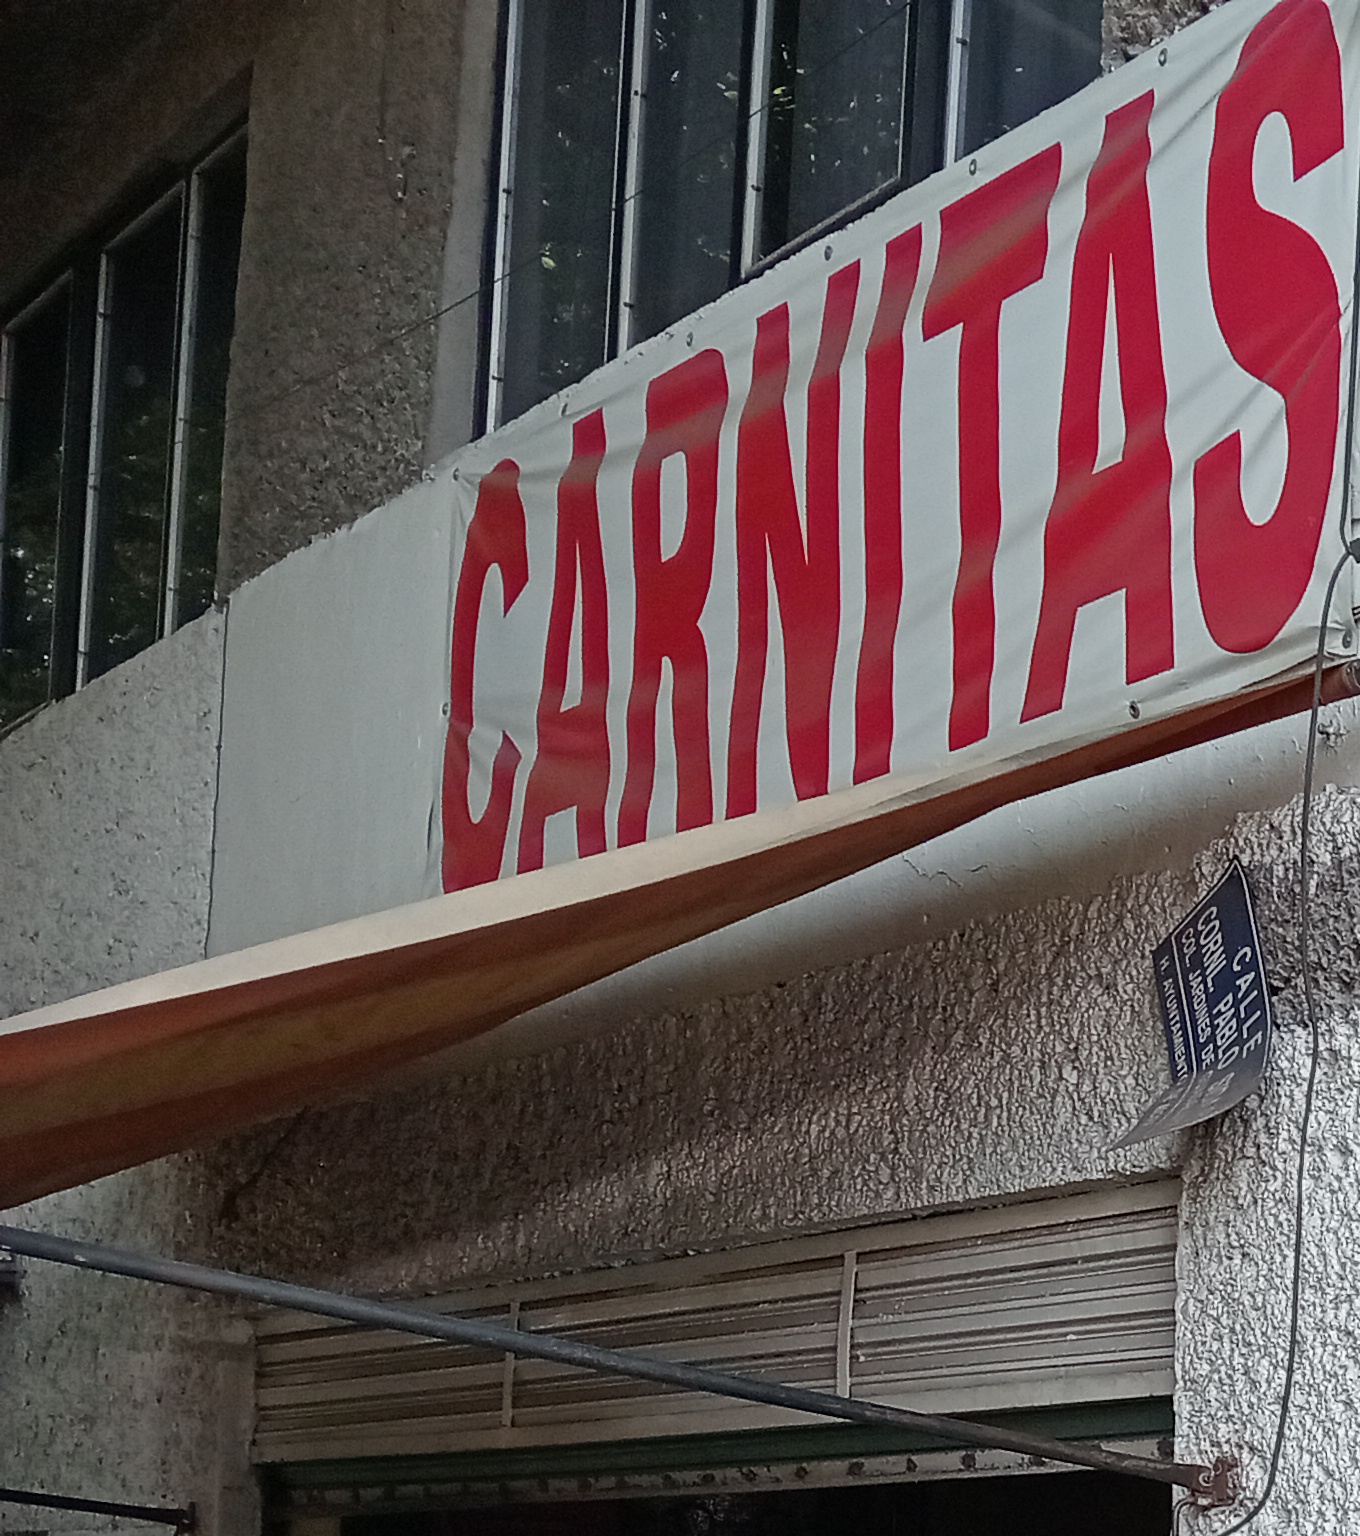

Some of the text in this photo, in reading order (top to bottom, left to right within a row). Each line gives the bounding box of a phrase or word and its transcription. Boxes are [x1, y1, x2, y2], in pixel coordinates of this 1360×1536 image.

[441, 0, 1345, 893] CARNITAS
[1188, 969, 1212, 1043] JARDINES
[1202, 1043, 1215, 1070] DE
[1197, 906, 1227, 993] CORNL.
[1212, 992, 1240, 1070] PABLO
[1232, 946, 1263, 1058] CALLE
